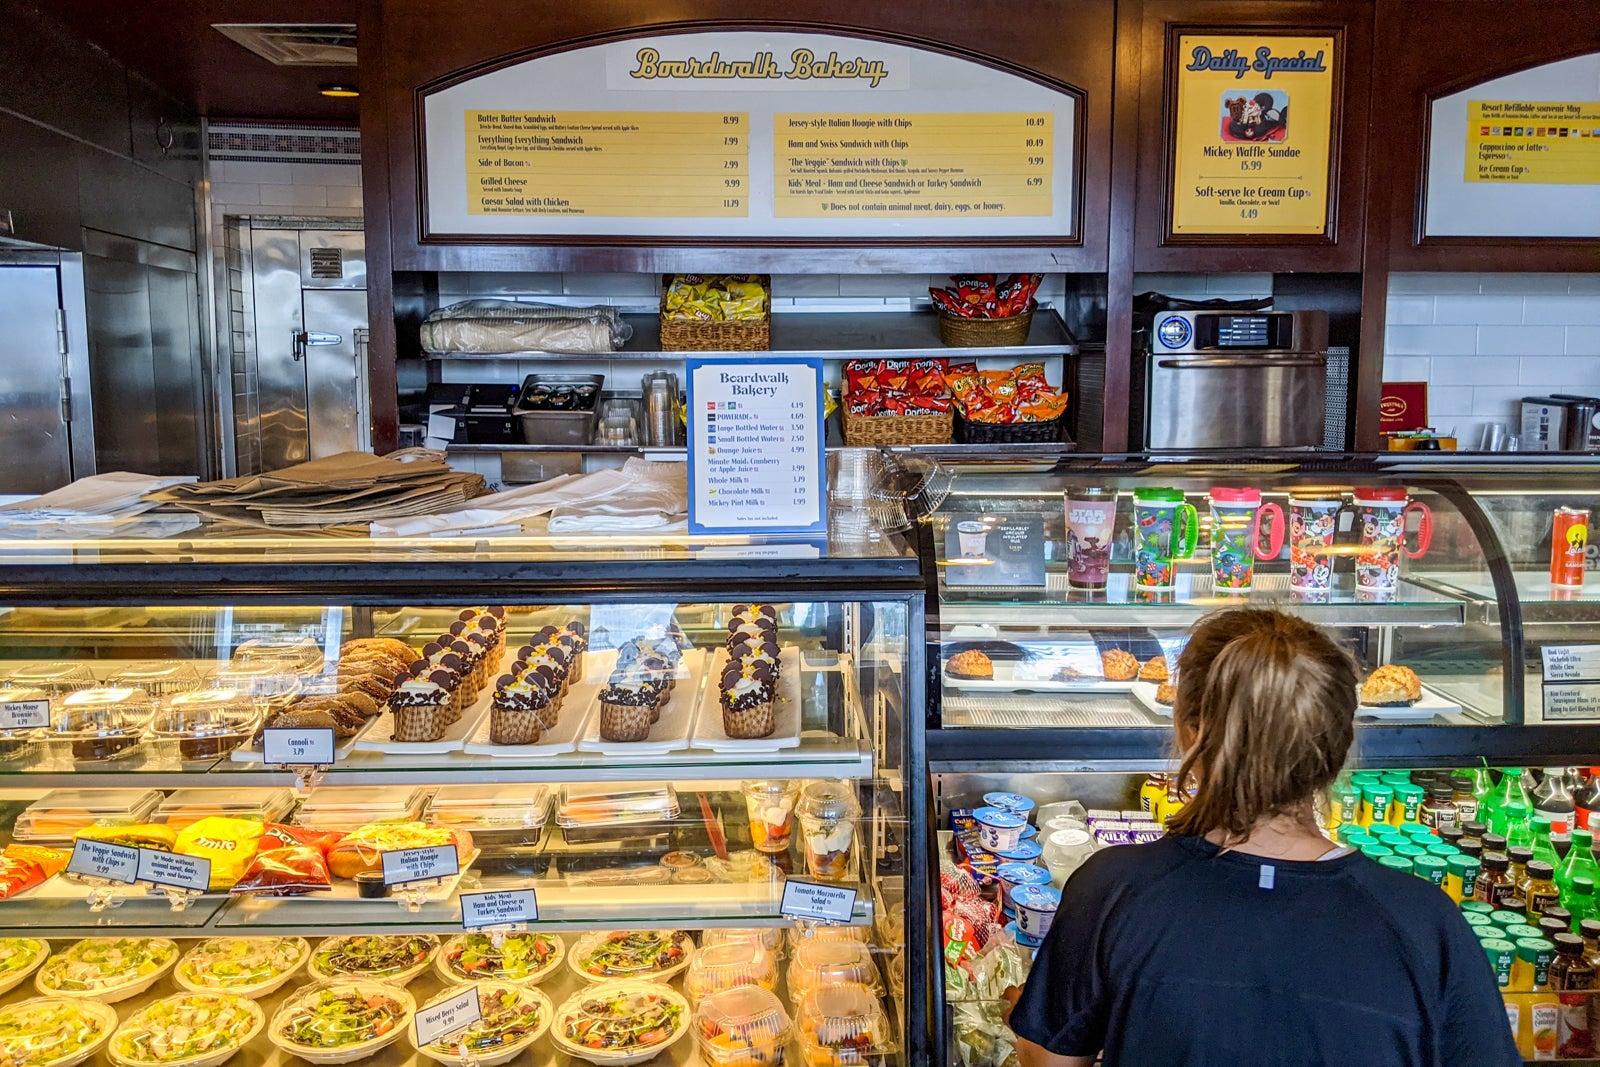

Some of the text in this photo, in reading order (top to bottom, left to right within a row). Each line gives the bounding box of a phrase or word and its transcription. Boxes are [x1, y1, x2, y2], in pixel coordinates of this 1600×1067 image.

[1186, 45, 1326, 79] Daily Special
[630, 48, 888, 88] Boardwalk Bakery
[1504, 103, 1535, 112] Refillable
[477, 114, 556, 123] Butter Butter Sandwich
[723, 116, 739, 125] 8.99
[1026, 118, 1045, 126] 10.49
[788, 118, 912, 129] Jersey-style Italian Hoagie with Chips
[478, 135, 583, 146] Everything Everything Sandwich
[724, 137, 739, 146] 7.99
[788, 139, 909, 150] Ham and Swiss Sandwich with Chips
[1025, 138, 1044, 147] 10.49
[1203, 146, 1301, 159] Mickey Waffle Sundae
[1479, 143, 1515, 153] Cappuccino
[1526, 143, 1543, 152] Latte
[1028, 156, 1044, 165] 9.99
[1478, 152, 1506, 161] Espresso
[478, 159, 524, 167] Side of Bacon
[724, 160, 739, 169] 2.99
[788, 157, 900, 169] "The Veggie" Sandwich with Chips
[1240, 160, 1262, 171] 15.99
[1478, 164, 1524, 175] Ice Cream Cup
[480, 177, 528, 186] Grilled Cheese
[724, 179, 740, 188] 9.99
[788, 179, 804, 187] Kids'
[805, 179, 821, 187] Meal
[828, 179, 843, 187] Ham
[845, 179, 857, 187] and
[859, 179, 883, 187] Cheese
[884, 179, 916, 187] Sandwich
[927, 179, 948, 189] Turkey
[949, 178, 982, 187] Sandwich
[1026, 177, 1043, 186] 6.99
[1195, 185, 1305, 200] Soft-serve Ice Cream Cup
[481, 197, 569, 206] Caesar Salad with Chicken
[723, 199, 739, 208] 11.79
[830, 202, 847, 211] Does
[848, 202, 860, 211] not
[861, 202, 887, 211] contain
[888, 202, 912, 211] animal
[913, 202, 933, 211] meat,
[983, 201, 1006, 211] honey.
[1240, 208, 1258, 219] 4.49
[720, 372, 789, 384] Boardwalk
[732, 384, 778, 397] Bakery
[717, 424, 734, 432] Large
[760, 424, 778, 432] Water
[717, 435, 735, 443] Small
[717, 447, 740, 455] Orange
[750, 457, 780, 466] Cranberry
[718, 466, 736, 474] Apple
[718, 487, 764, 495] Chocolate Milk
[708, 499, 729, 507] Mickey
[1071, 508, 1104, 517] STAR
[1069, 515, 1106, 524] WARS
[288, 738, 309, 746] Cannoli
[1099, 831, 1128, 841] MILK
[81, 843, 137, 861] The Veggie Sandwich
[91, 855, 120, 868] with Chips
[160, 855, 195, 867] Made without
[400, 853, 439, 864] Italian Hoagie
[96, 865, 110, 874] 9.99
[151, 861, 169, 870] animal
[405, 861, 435, 871] with Chips
[166, 871, 177, 879] and
[413, 869, 429, 878] 10.49
[794, 886, 846, 900] Tomato Mozzarella
[472, 901, 486, 909] Ham
[498, 899, 518, 907] Cheese
[810, 896, 827, 905] Salad
[477, 905, 523, 916] Turkey Sandwich
[425, 998, 470, 1024] Mixed Berry Salad
[442, 1015, 455, 1026] 9.99
